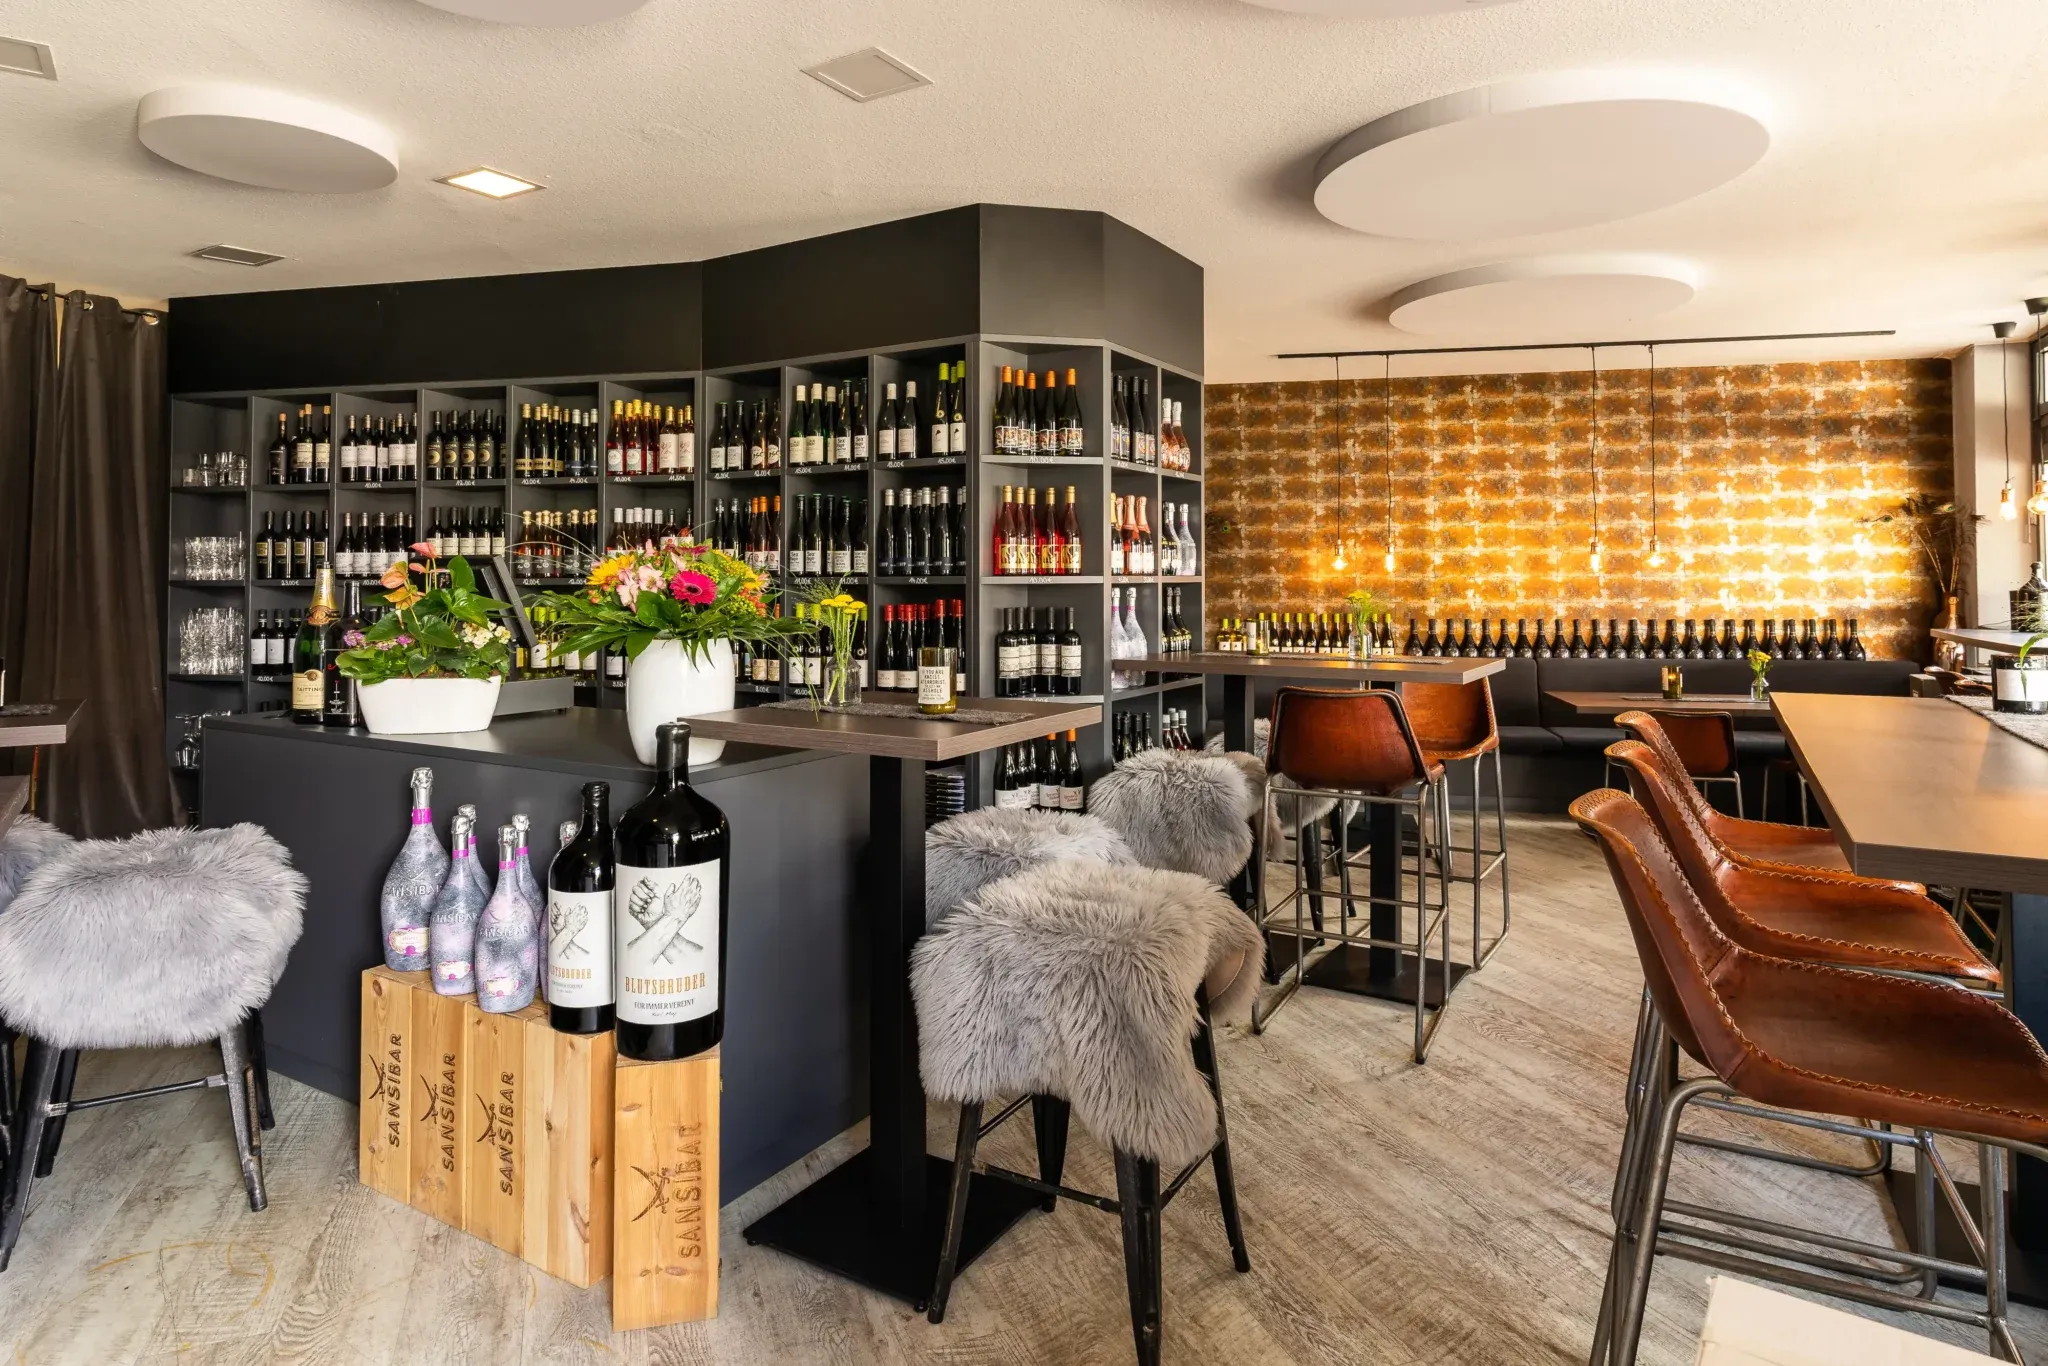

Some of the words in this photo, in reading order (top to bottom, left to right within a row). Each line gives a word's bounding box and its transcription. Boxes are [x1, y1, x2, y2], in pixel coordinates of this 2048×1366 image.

[387, 1033, 402, 1148] SANSIBAR
[440, 1053, 456, 1172] SANSIBAR
[498, 1071, 514, 1196] SANSIBAR
[672, 1122, 702, 1259] SANSIBAR
